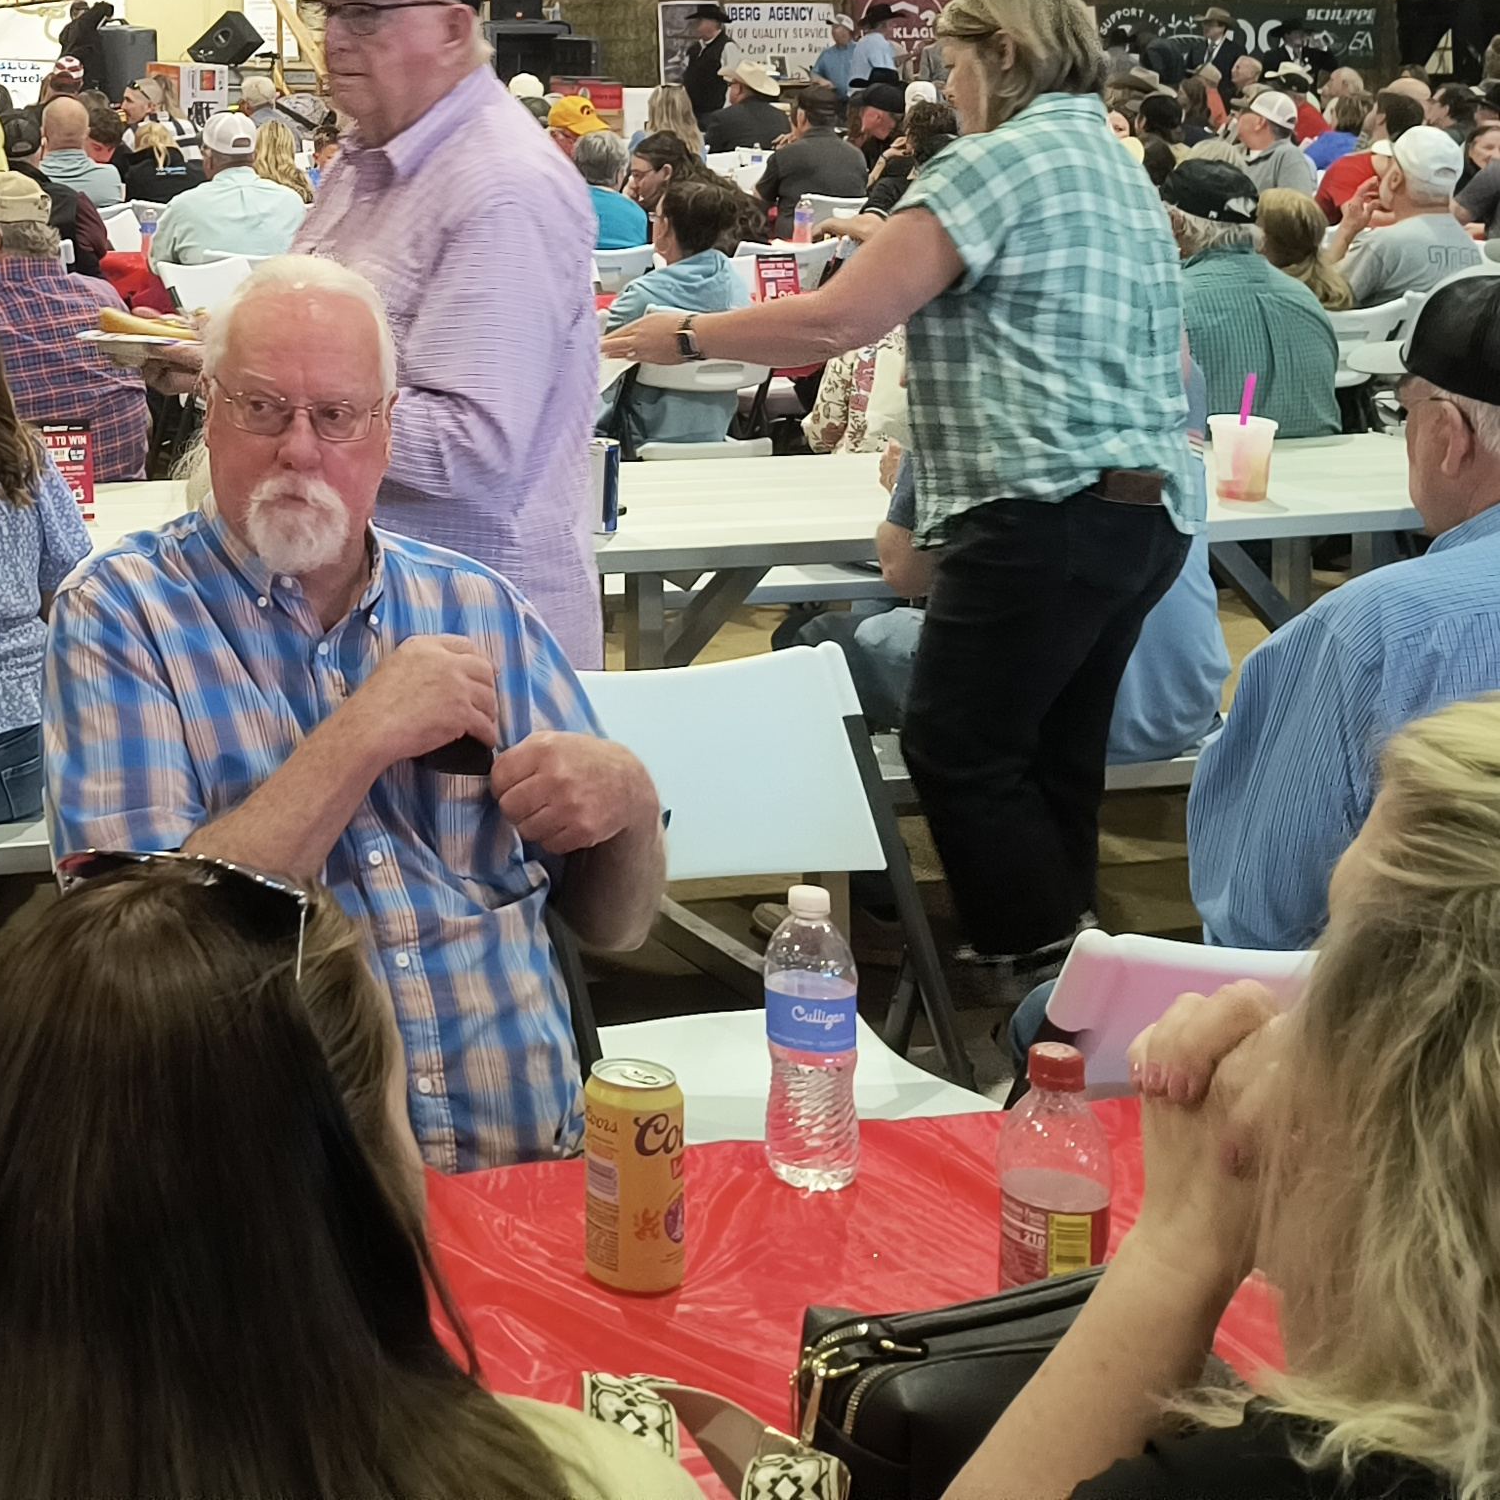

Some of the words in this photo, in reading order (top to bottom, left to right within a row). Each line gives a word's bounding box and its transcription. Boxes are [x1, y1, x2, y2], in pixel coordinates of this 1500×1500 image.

[738, 27, 748, 38] OF
[752, 28, 789, 39] QUALITY
[792, 27, 829, 39] SERVICE
[55, 435, 67, 446] TO
[69, 434, 87, 446] WIN
[791, 1005, 846, 1031] Culligan
